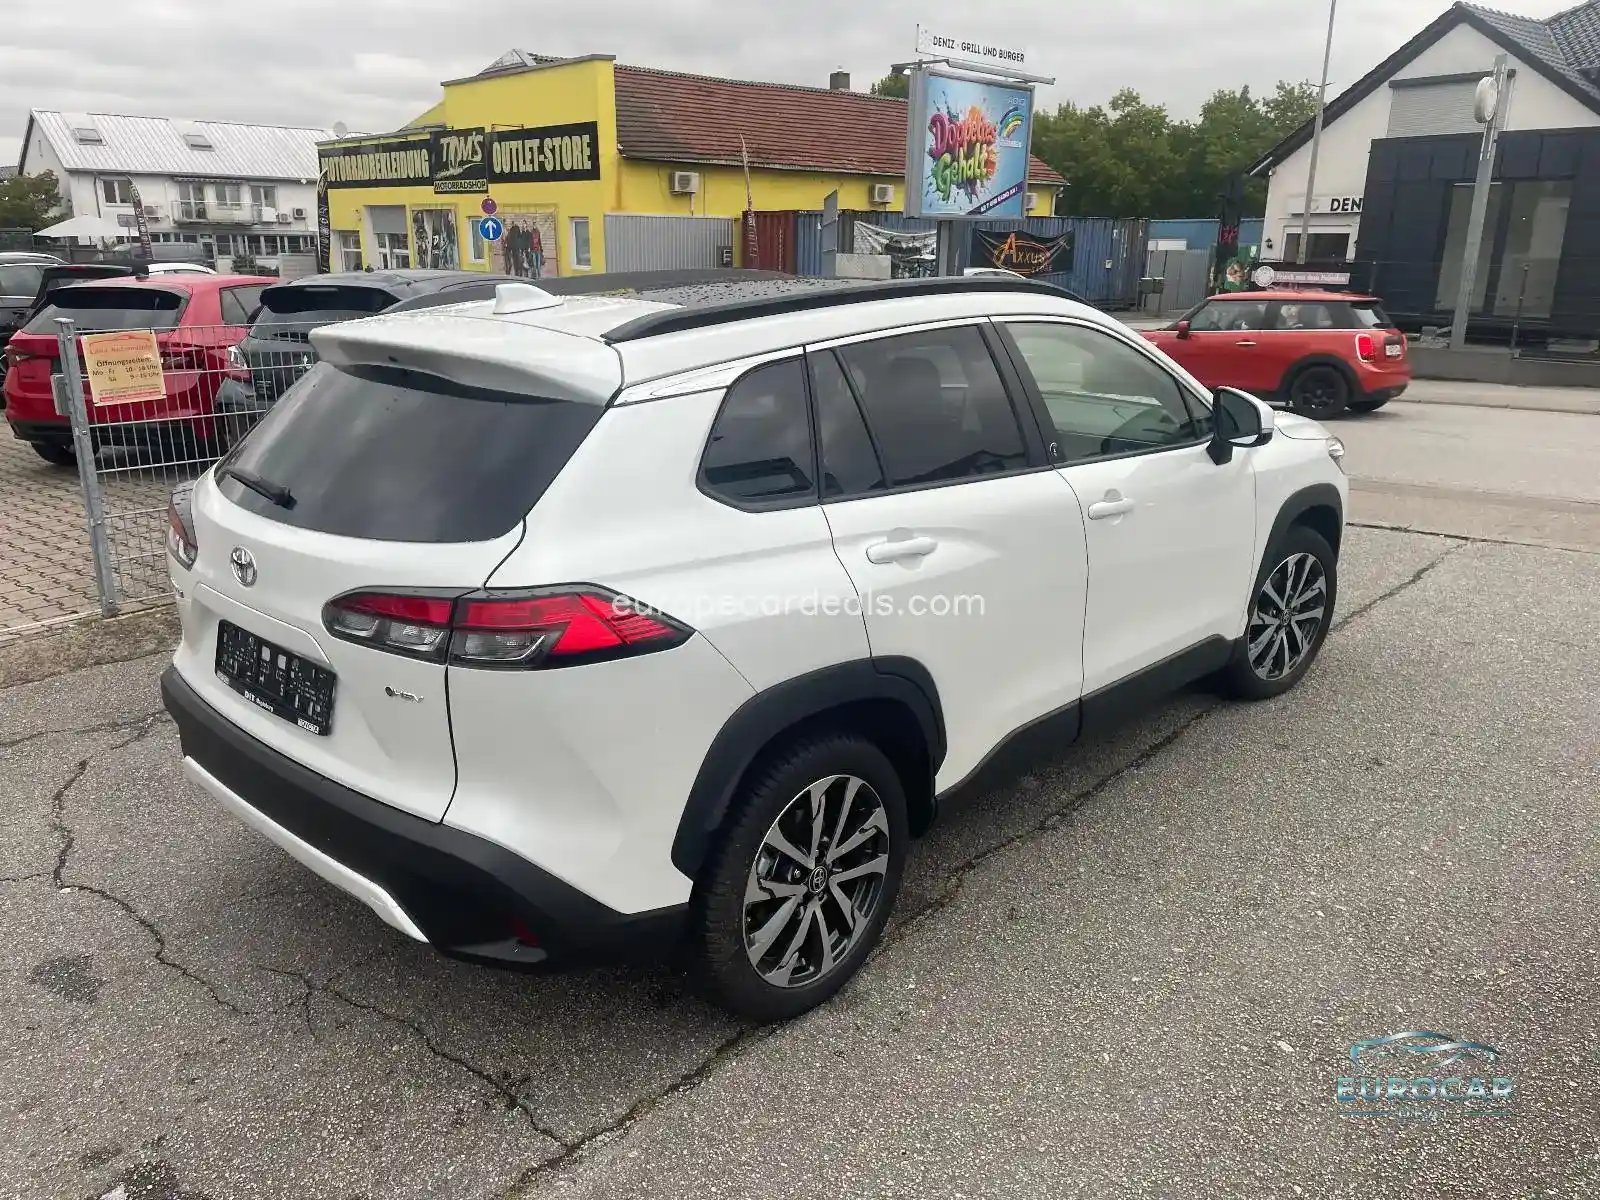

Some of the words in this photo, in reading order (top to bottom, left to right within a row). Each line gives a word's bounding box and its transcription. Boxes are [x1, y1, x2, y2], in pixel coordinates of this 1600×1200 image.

[932, 36, 956, 49] DENIZ
[961, 41, 981, 54] GRILL
[982, 46, 998, 57] UND
[998, 49, 1025, 63] BURGER
[492, 134, 592, 174] OUTLET-STORE
[434, 180, 487, 190] MOTORRADSHOP
